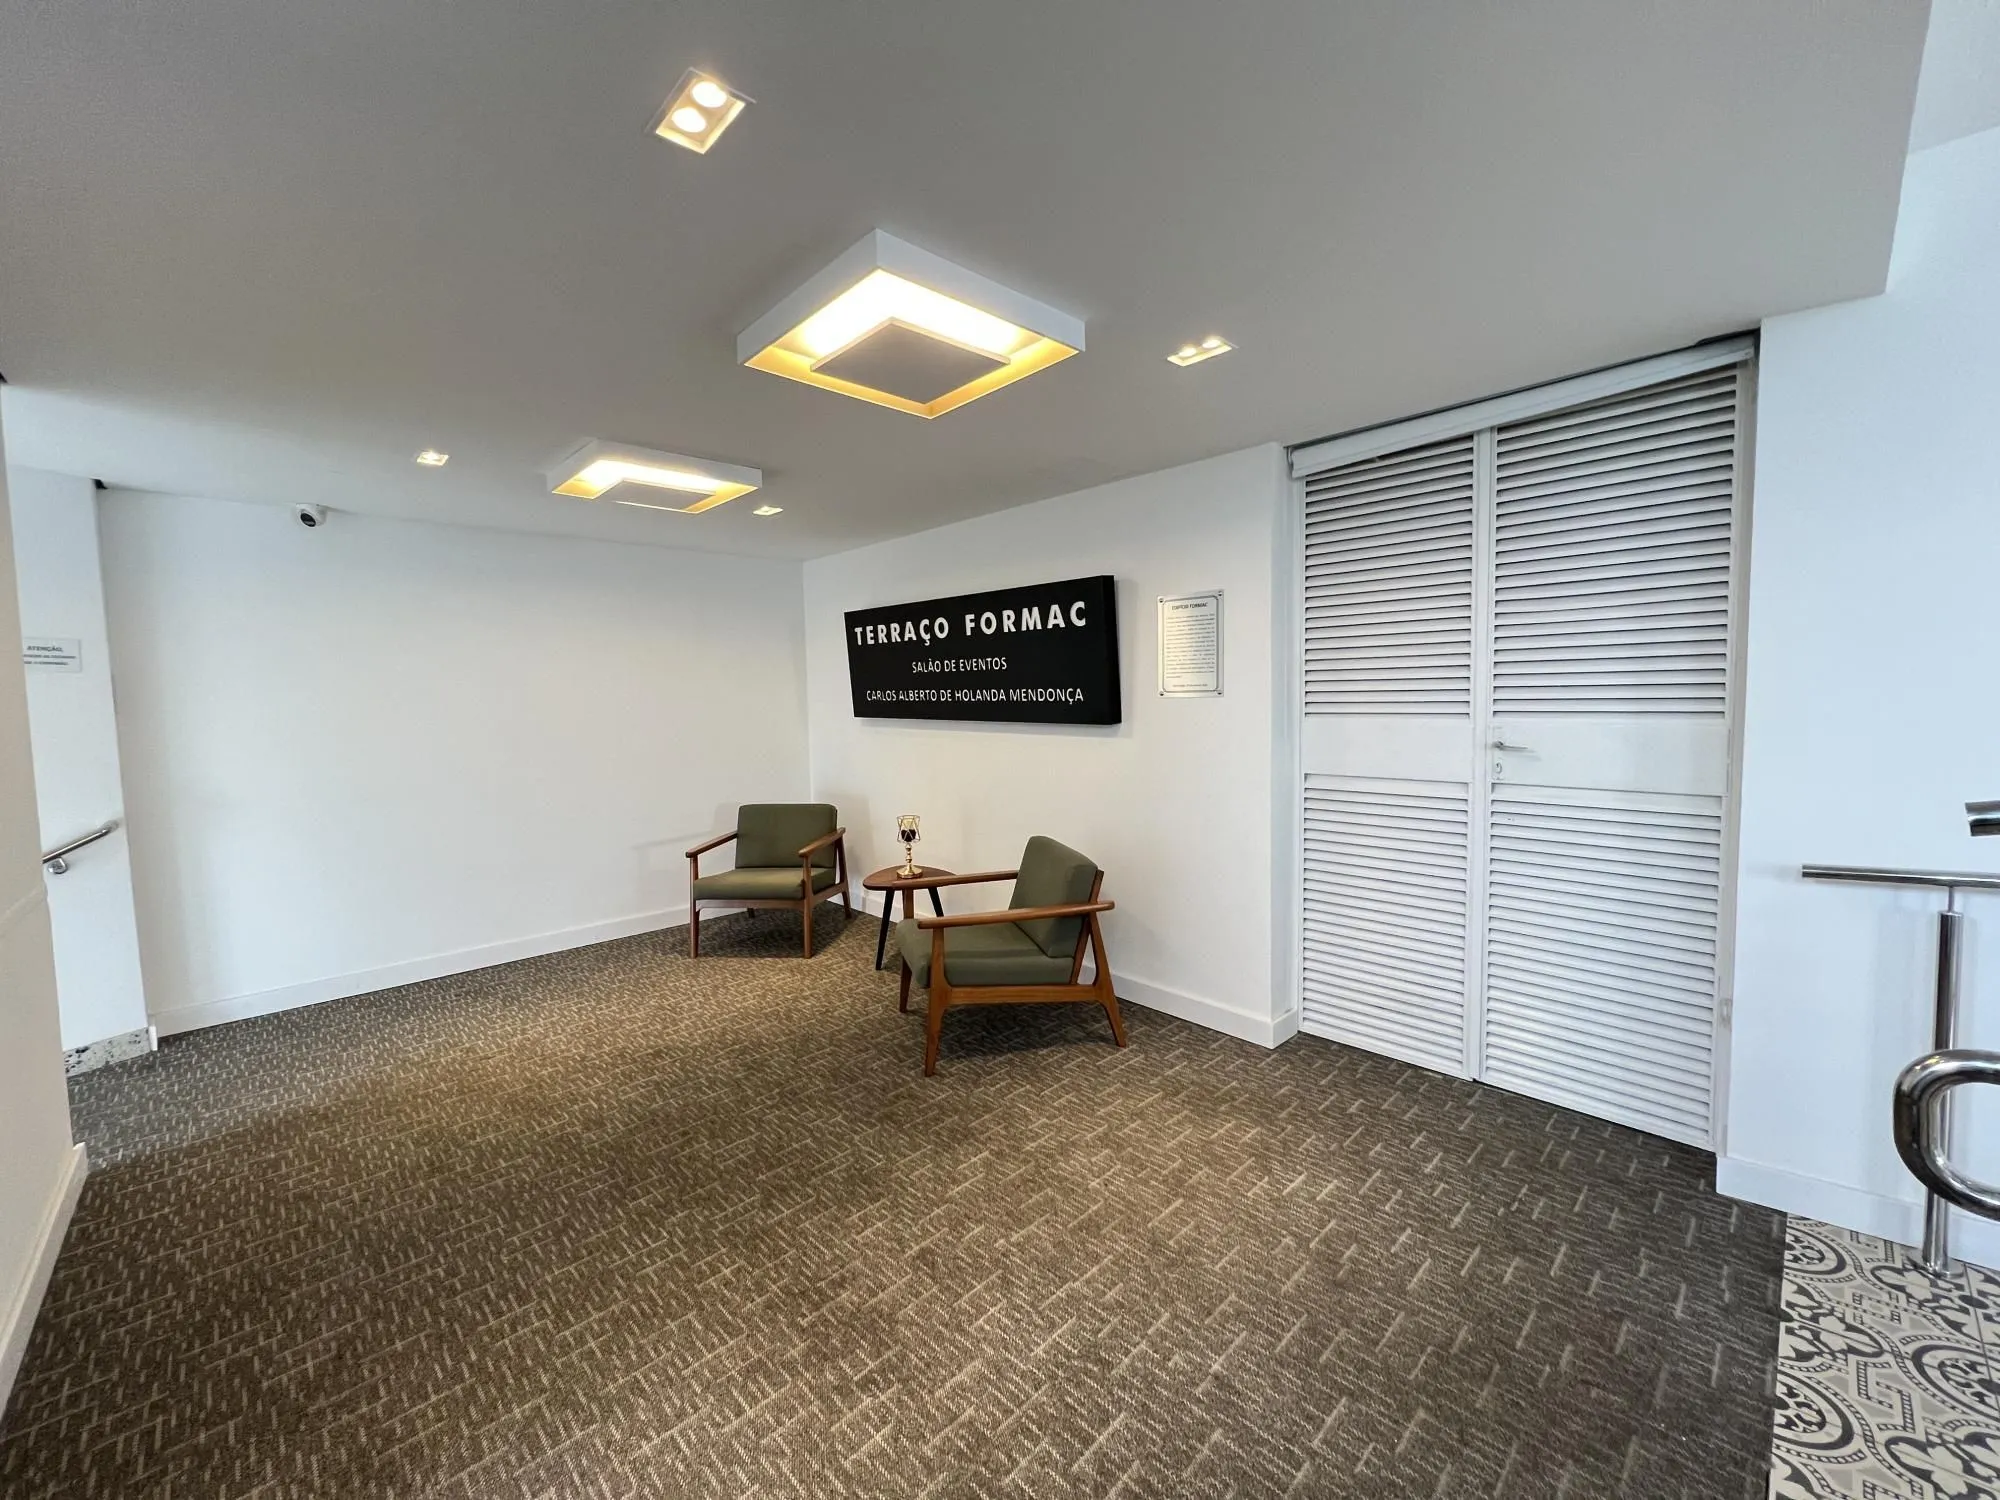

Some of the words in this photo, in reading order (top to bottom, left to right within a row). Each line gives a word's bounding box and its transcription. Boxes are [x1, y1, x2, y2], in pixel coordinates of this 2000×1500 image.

[855, 617, 949, 646] TERRAÇO
[965, 601, 1087, 636] FORMAC
[912, 658, 941, 673] SALÃO
[944, 660, 956, 672] DE
[960, 657, 1007, 672] EVENTOS
[866, 690, 897, 702] CARLOS
[899, 689, 937, 702] ALBERTO
[940, 689, 952, 702] DE
[955, 688, 1006, 702] HOLANDA
[1009, 687, 1084, 704] MENDONÇA
